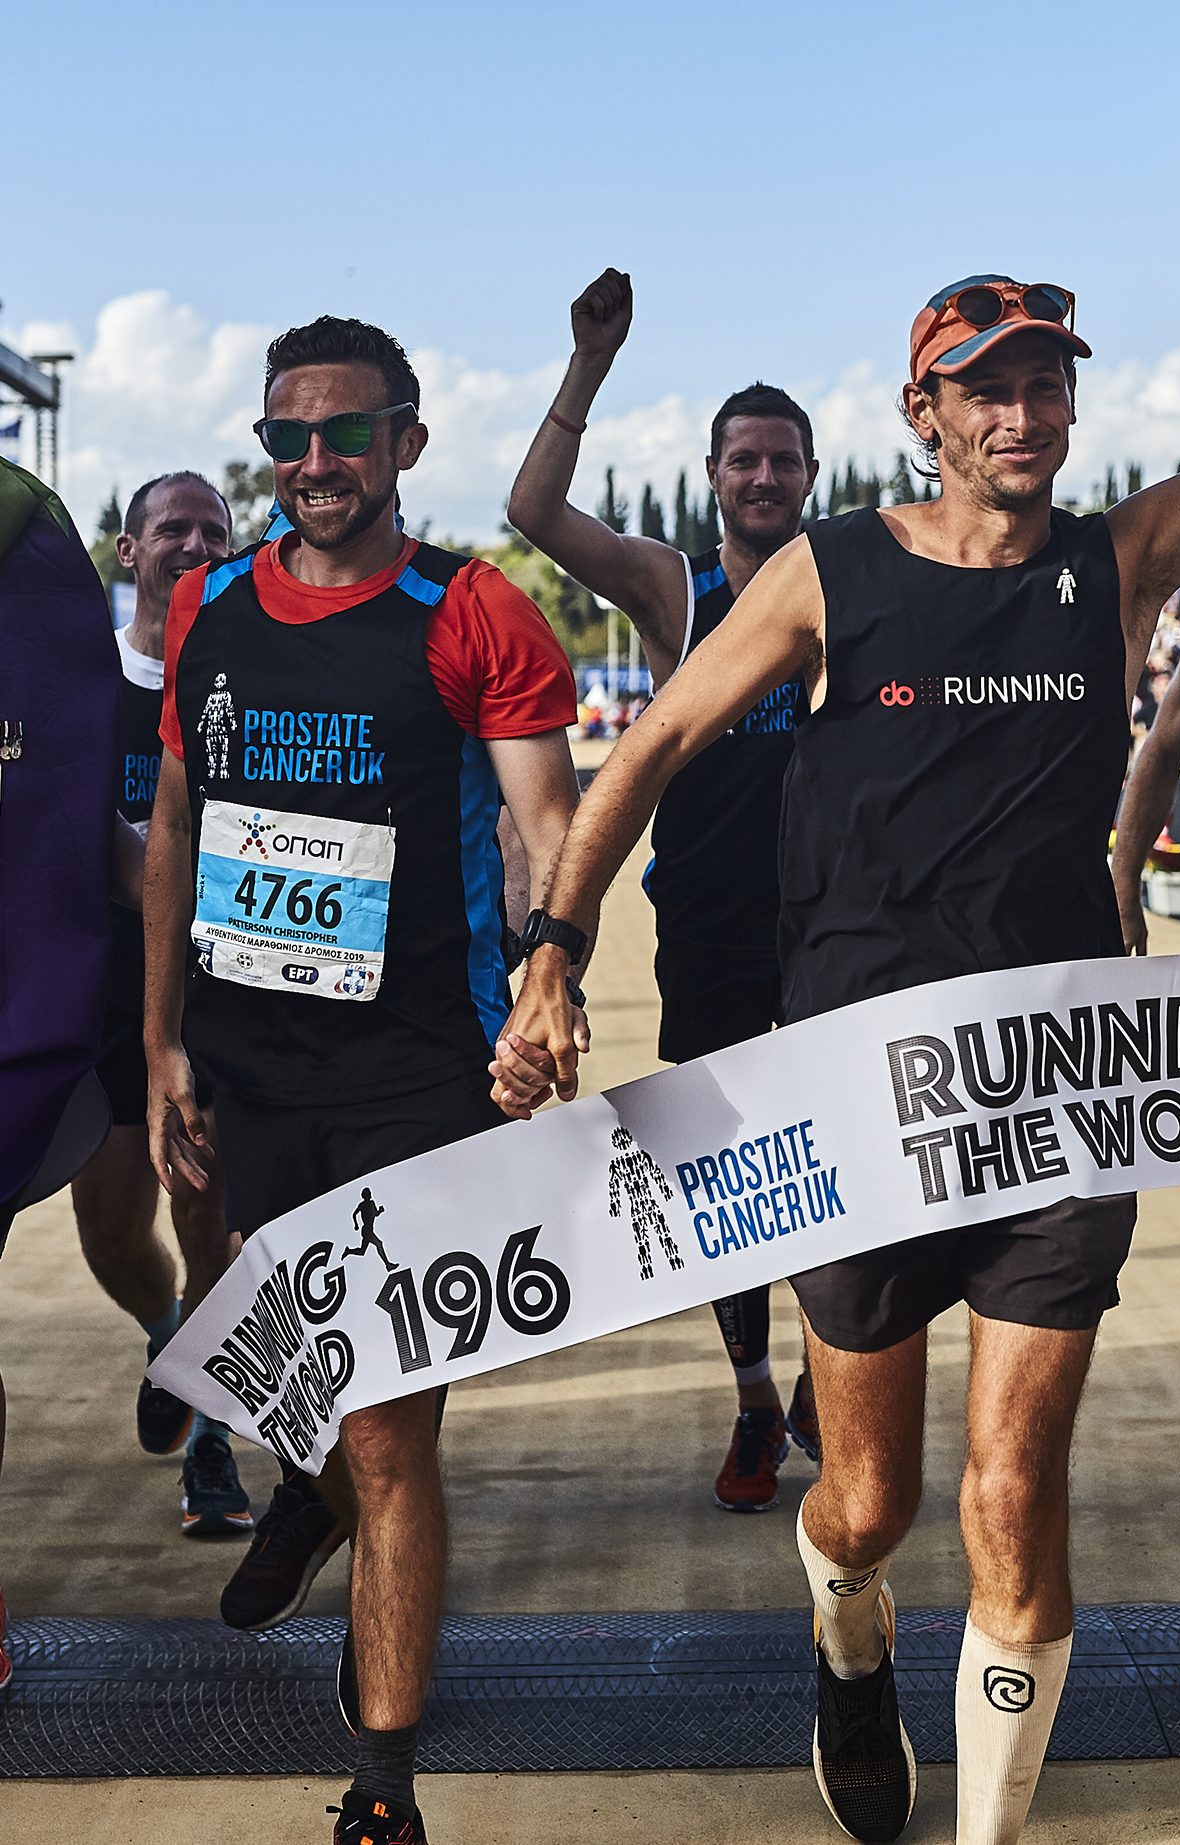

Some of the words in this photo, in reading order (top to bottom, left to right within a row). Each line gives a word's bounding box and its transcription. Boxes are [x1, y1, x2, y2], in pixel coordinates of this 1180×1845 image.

[943, 673, 1085, 705] RUNNING
[244, 709, 374, 749] PROSTATE
[243, 746, 343, 784] CANCER
[349, 751, 386, 785] UK
[234, 869, 342, 930] 4766
[205, 926, 247, 944] ΑΥΘΕΝΤΙΚΟΣ
[247, 937, 304, 954] ΜΑΡΑΘΩΝΙΟΣ
[304, 945, 342, 959] ΔΡΟΜΟΣ
[344, 951, 365, 962] 2019
[228, 916, 273, 935] PATTERSON
[273, 926, 338, 944] CHRISTOPHER
[675, 1118, 821, 1211] PROSTATE
[903, 1106, 1069, 1206] THE
[693, 1181, 807, 1260] CANCER
[803, 1166, 846, 1224] UK
[375, 1224, 572, 1375] 196
